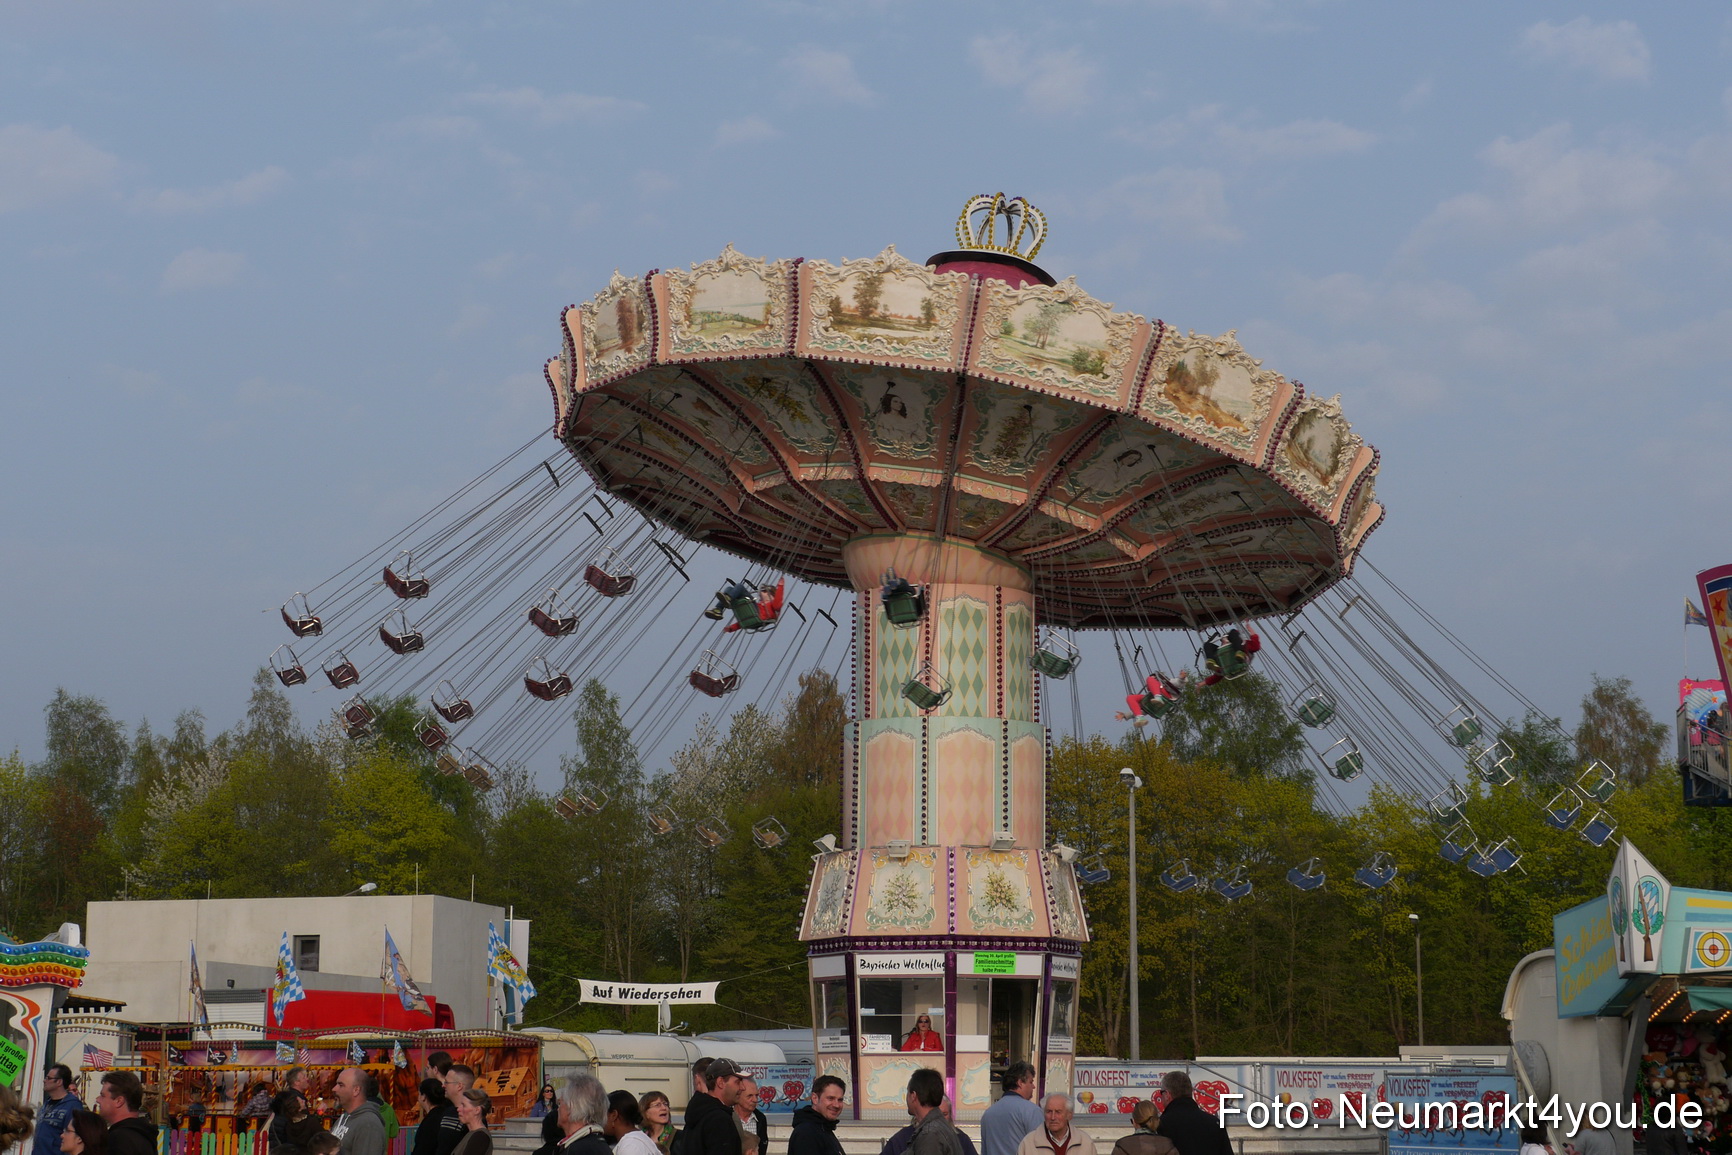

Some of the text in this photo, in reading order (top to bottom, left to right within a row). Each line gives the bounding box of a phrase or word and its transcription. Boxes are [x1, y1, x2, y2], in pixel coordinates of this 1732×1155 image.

[860, 958, 901, 972] Bayrischer
[592, 985, 702, 1000] Auf Wiedersehen
[3, 1045, 26, 1062] großer
[1076, 1070, 1131, 1087] VOLKSFEST
[1276, 1070, 1323, 1088] VOLKSFEST
[1388, 1079, 1431, 1097] VOLKSFEST
